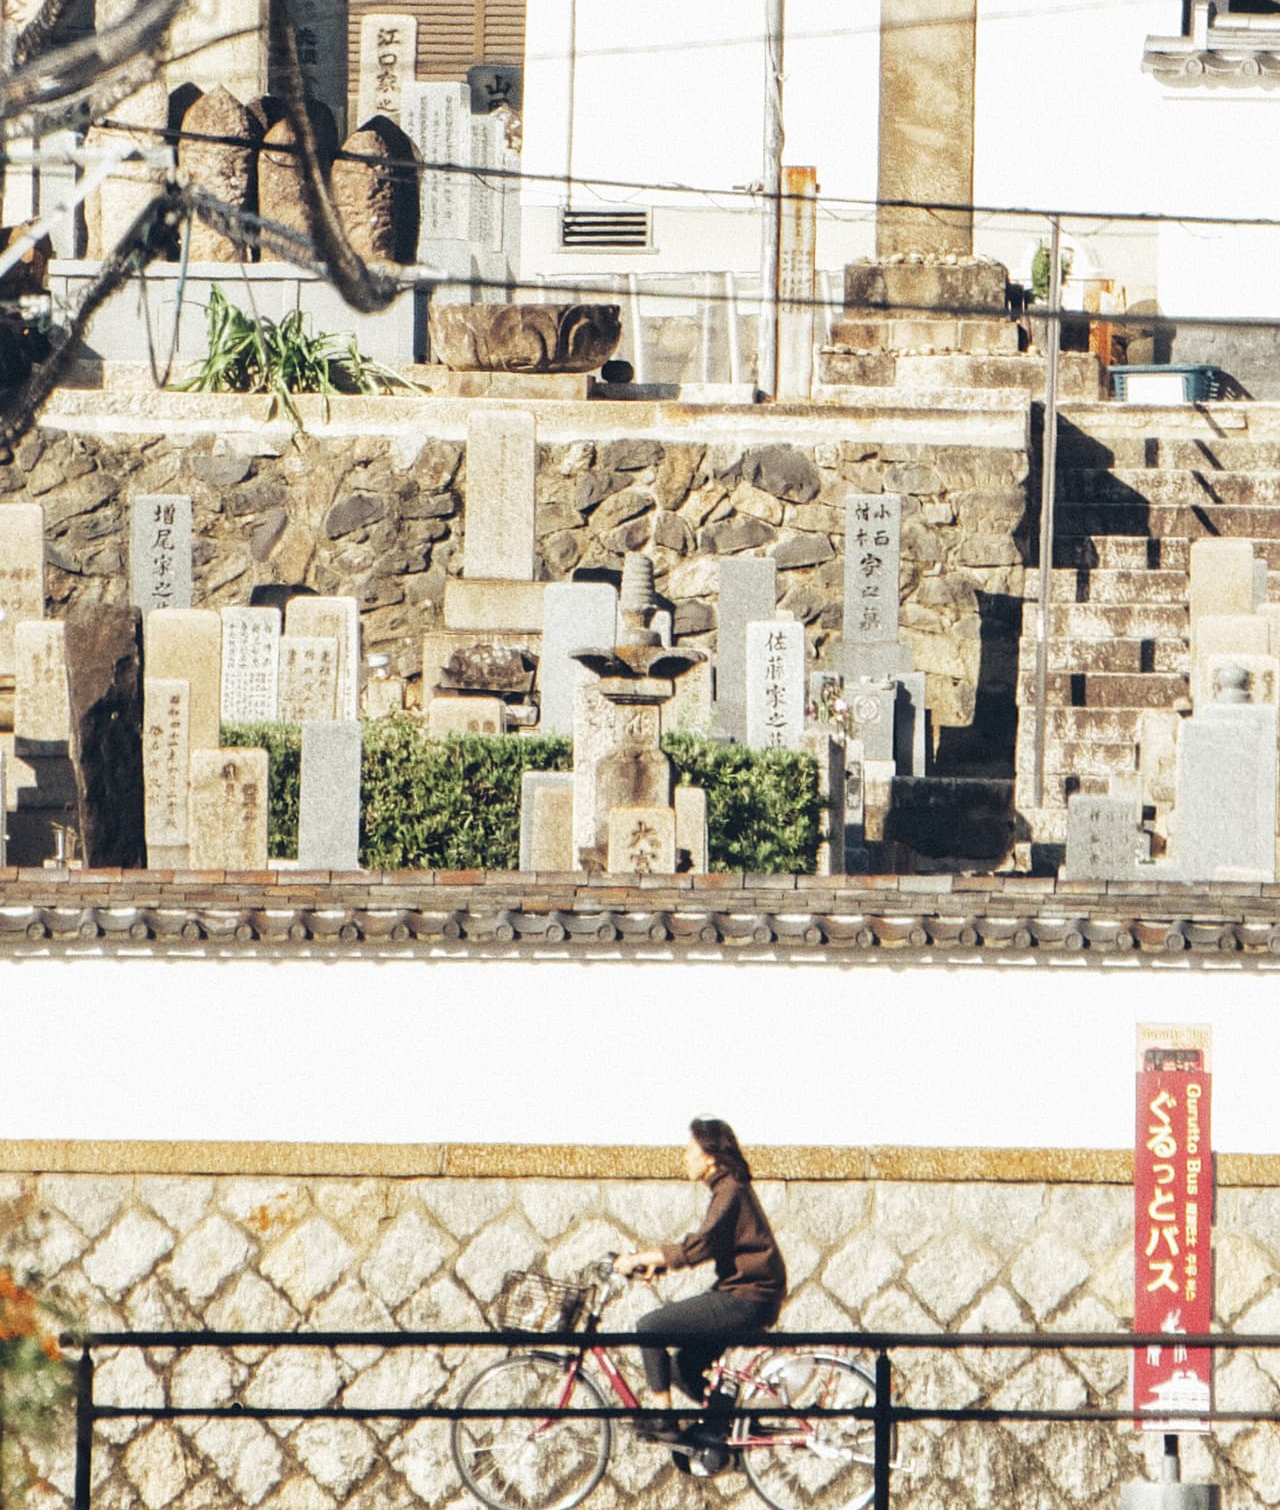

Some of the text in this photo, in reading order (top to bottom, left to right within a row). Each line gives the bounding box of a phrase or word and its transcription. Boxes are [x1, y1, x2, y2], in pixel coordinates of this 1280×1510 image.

[152, 503, 176, 609] 増尾家之
[1146, 1091, 1181, 1293] ぐるっとバス
[1186, 1158, 1202, 1196] Bus
